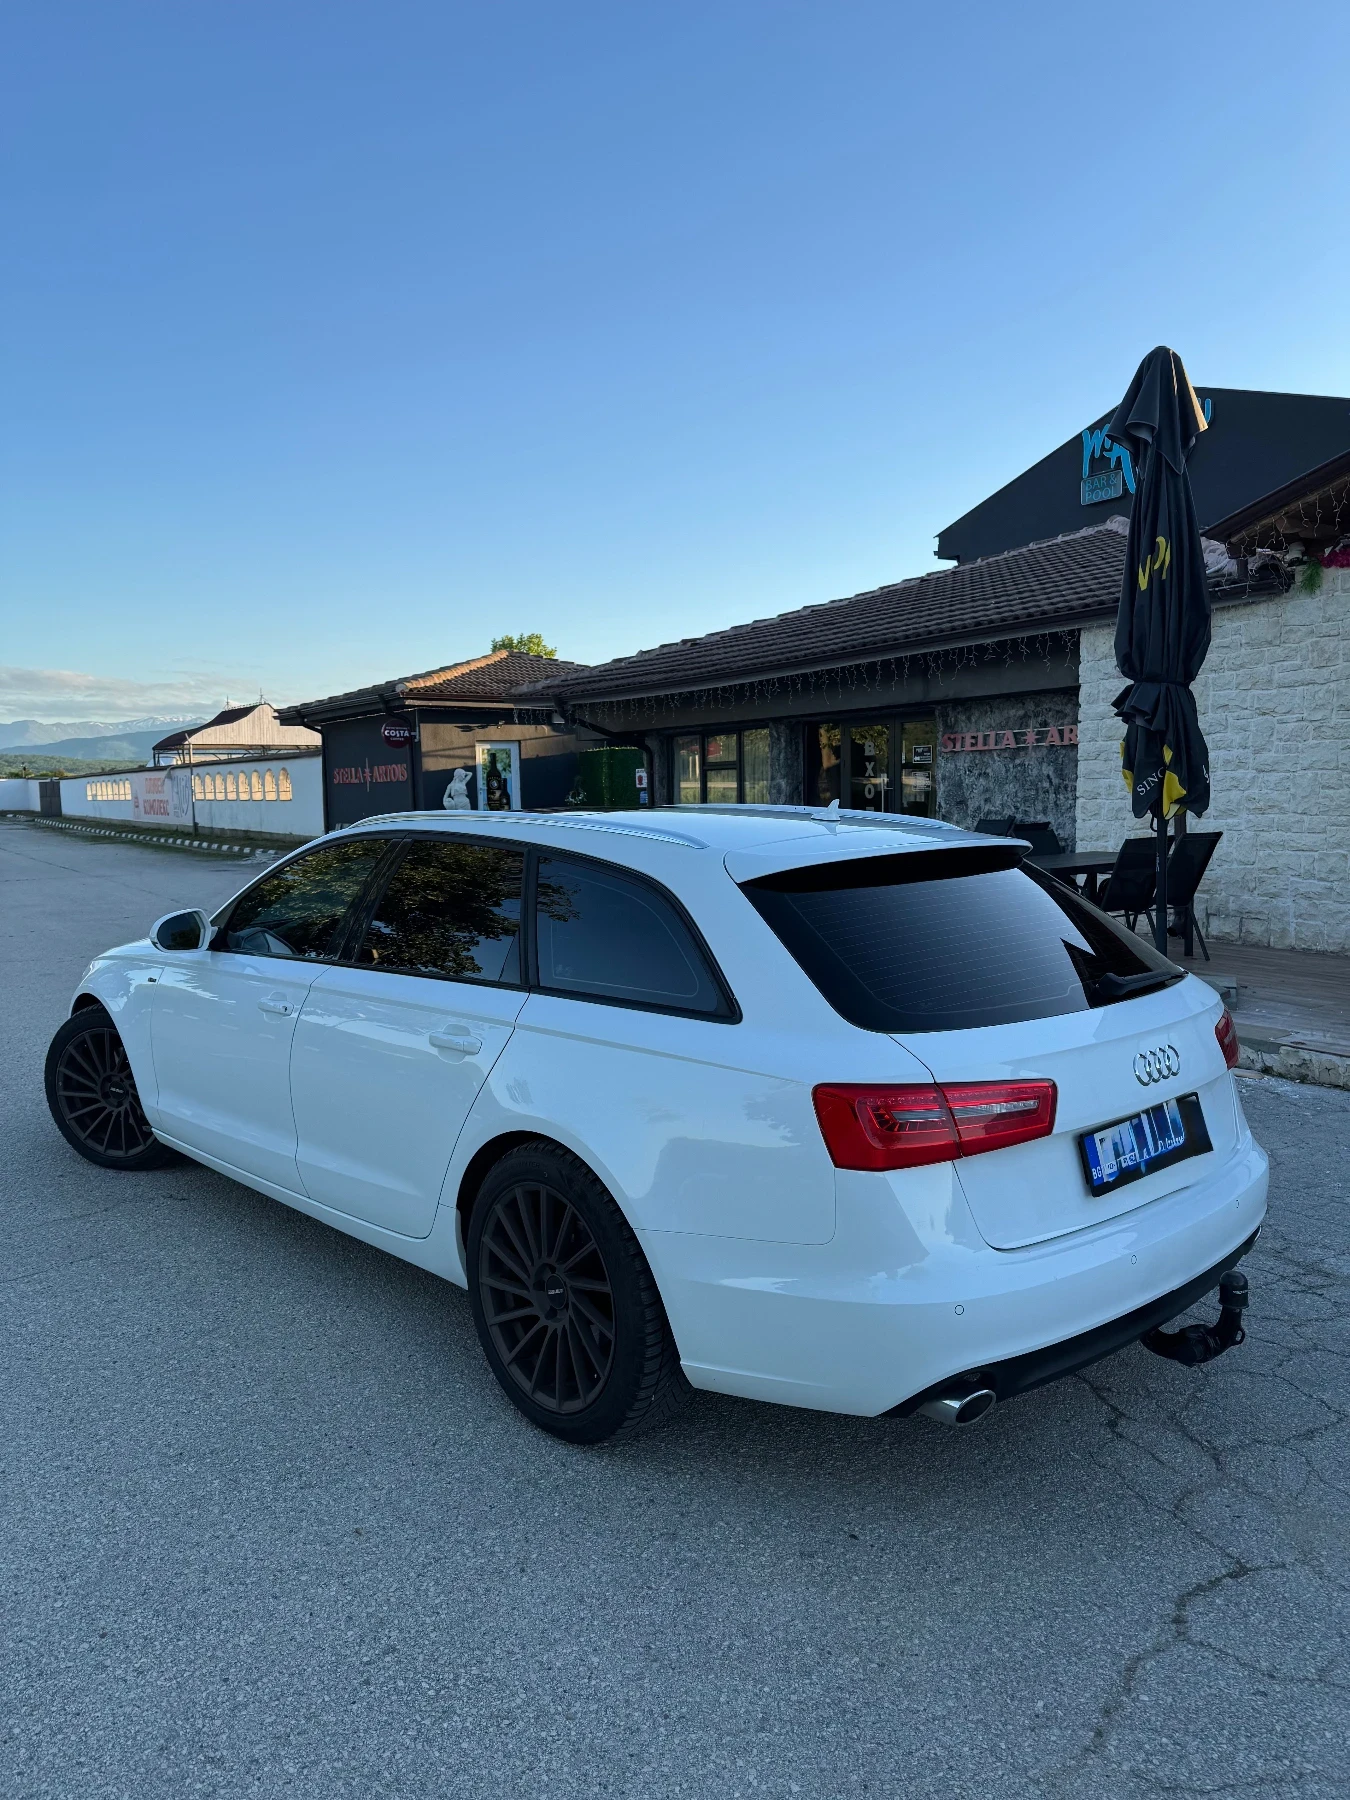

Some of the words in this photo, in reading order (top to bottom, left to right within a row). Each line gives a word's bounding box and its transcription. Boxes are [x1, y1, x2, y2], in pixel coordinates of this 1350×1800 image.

[1085, 474, 1107, 491] BAR
[1109, 473, 1118, 485] &
[1085, 486, 1117, 503] POOL
[384, 730, 410, 738] COSTA
[941, 729, 1018, 753] STELLA
[333, 767, 364, 785] STELLA
[372, 763, 408, 783] ARTOIS
